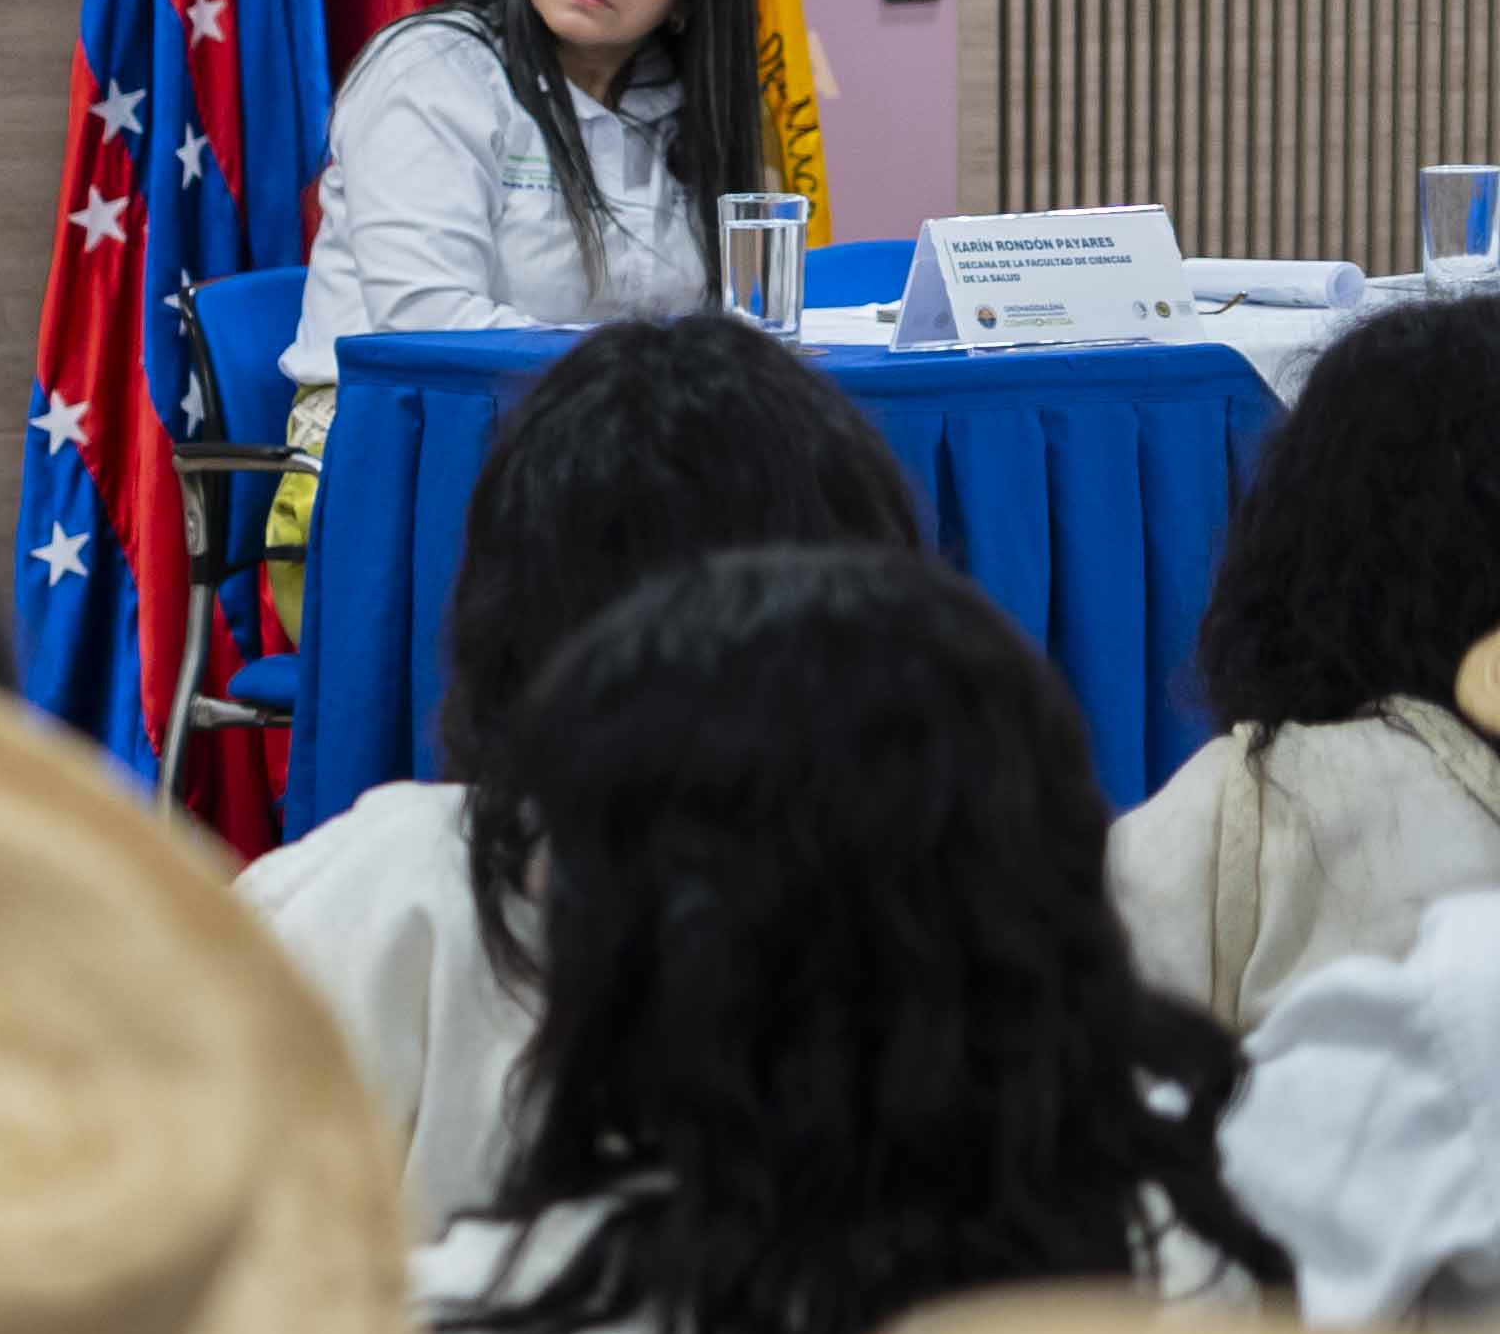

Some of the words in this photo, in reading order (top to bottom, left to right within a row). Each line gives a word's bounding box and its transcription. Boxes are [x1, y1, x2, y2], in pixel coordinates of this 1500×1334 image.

[952, 238, 993, 253] KARÍN
[995, 236, 1054, 252] RONDÓN
[1057, 236, 1115, 249] PAYARES
[1026, 257, 1074, 268] FACULTAD
[1088, 254, 1132, 265] CIENCIAS
[990, 273, 1021, 283] SALUD
